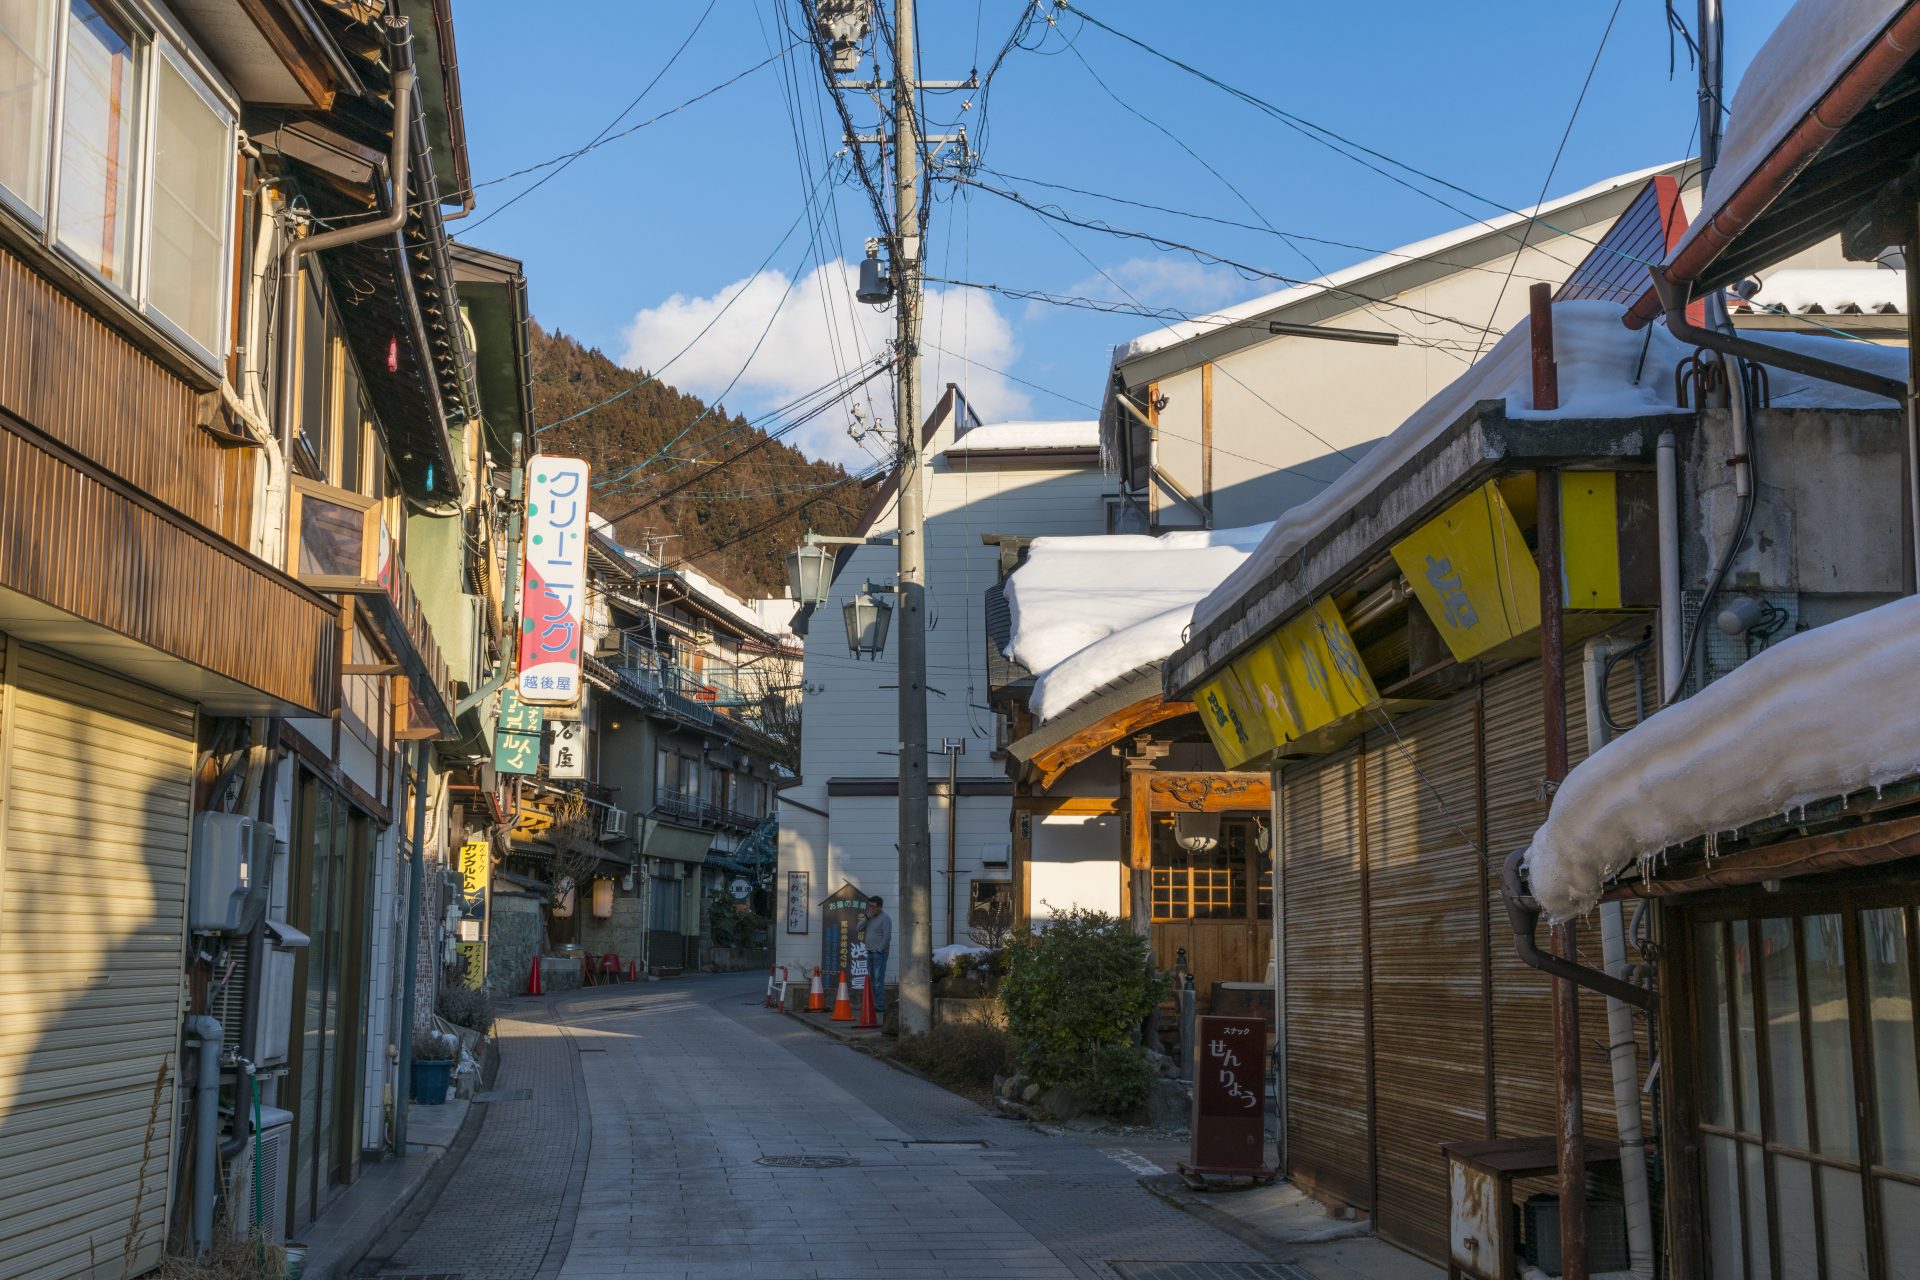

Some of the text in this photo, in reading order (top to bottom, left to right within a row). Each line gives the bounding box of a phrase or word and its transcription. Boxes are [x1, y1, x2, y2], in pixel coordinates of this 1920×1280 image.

[540, 470, 580, 653] クリーニング
[523, 676, 572, 691] 越後屋
[463, 843, 477, 891] アンクルトム
[478, 844, 486, 873] スナック
[790, 884, 799, 928] わかたけ
[1223, 1027, 1250, 1035] スナック
[1208, 1039, 1258, 1109] せんりょう
